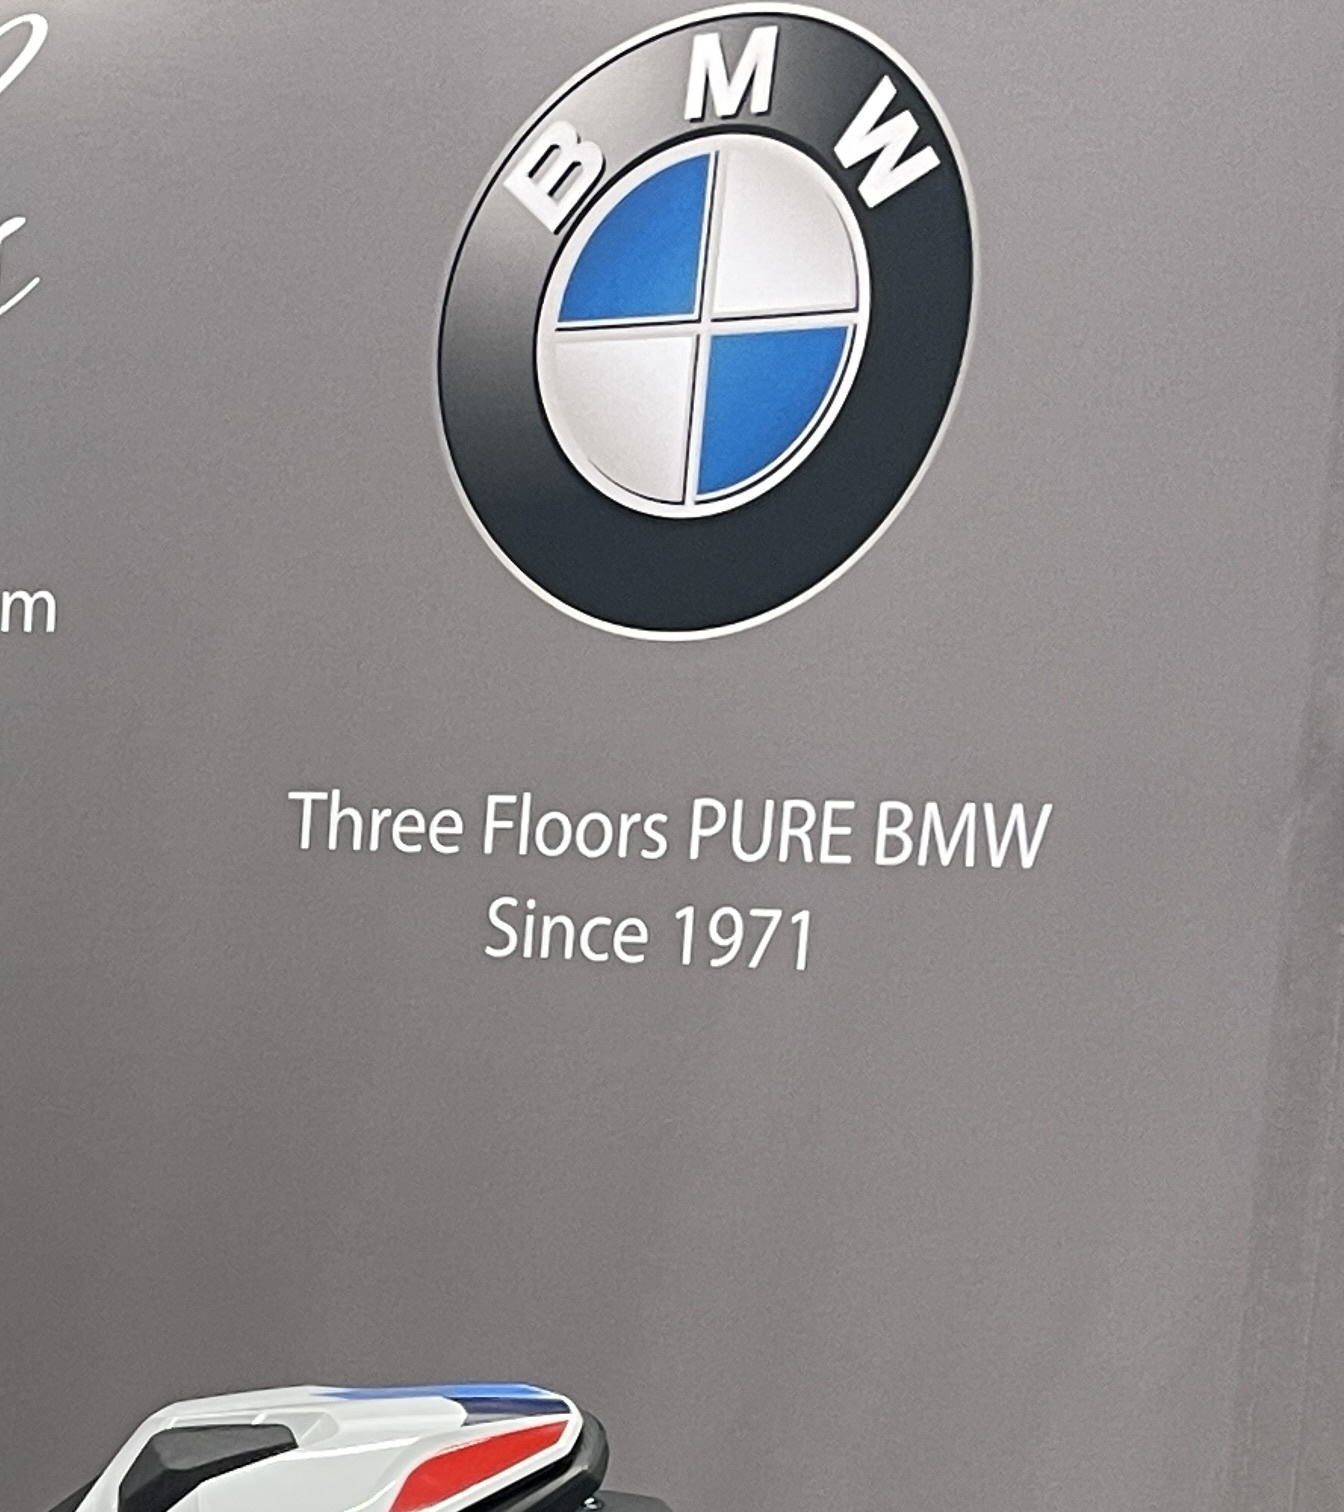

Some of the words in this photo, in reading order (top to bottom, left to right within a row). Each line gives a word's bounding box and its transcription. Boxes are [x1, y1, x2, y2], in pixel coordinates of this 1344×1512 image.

[503, 26, 941, 235] BMW
[286, 787, 464, 855] Three
[483, 791, 669, 861] Floors
[689, 797, 855, 865] PURE
[875, 801, 1053, 869] BMW
[484, 896, 649, 965] Since
[675, 905, 811, 971] 1971
